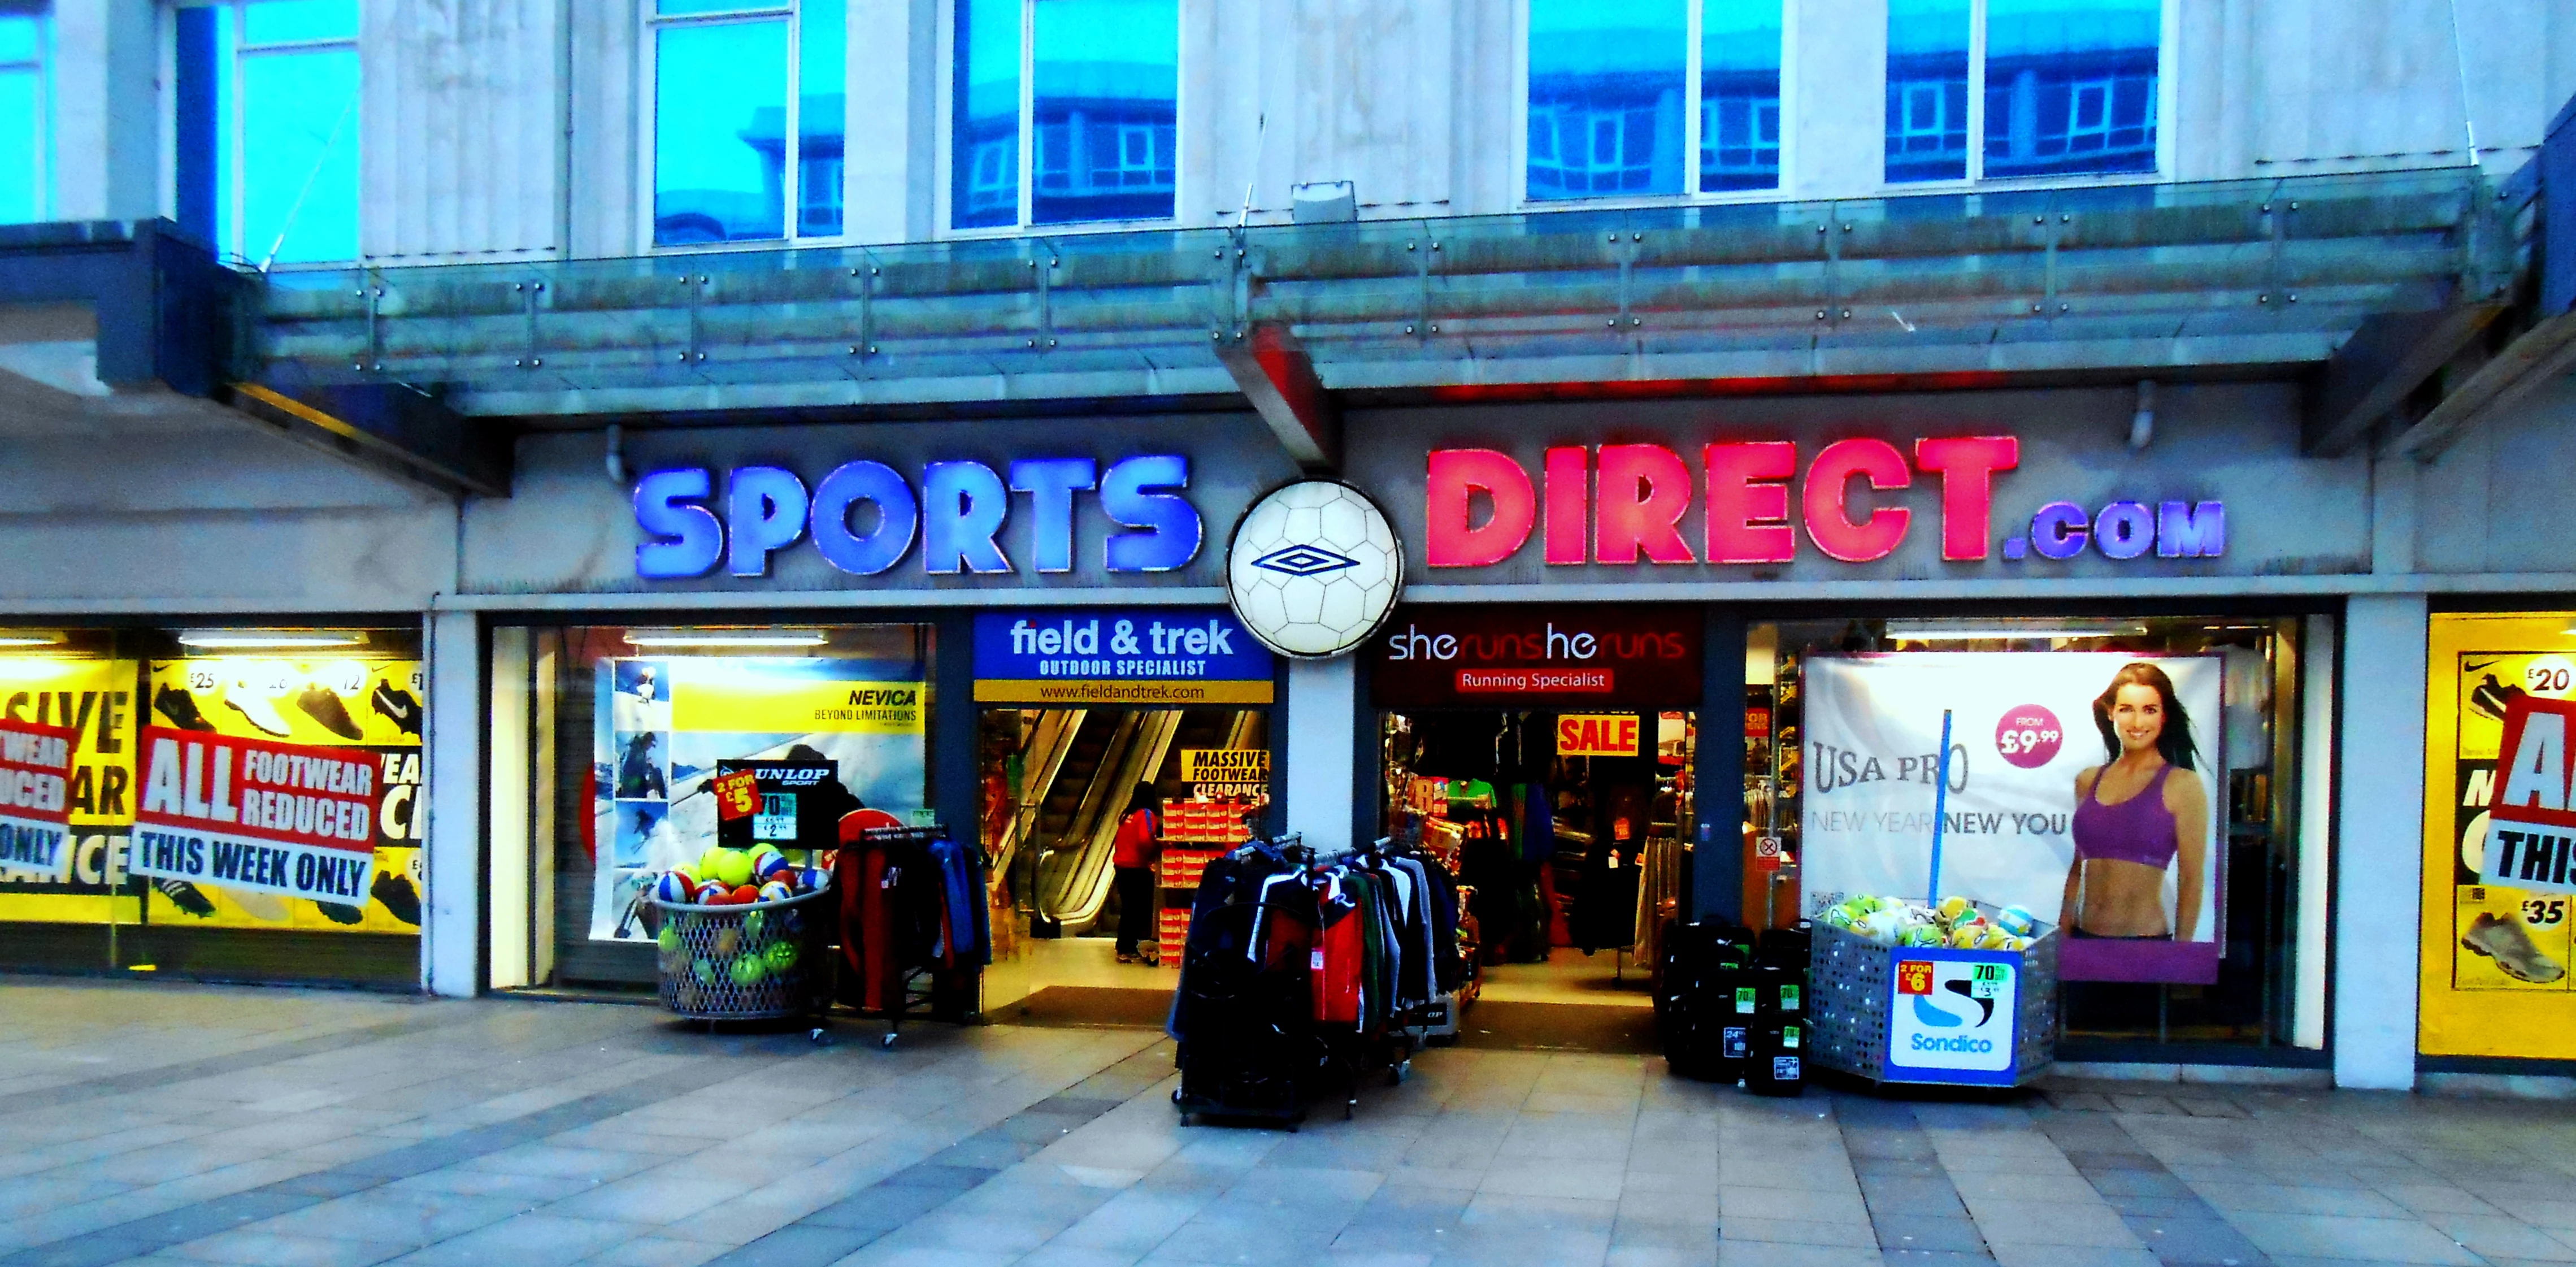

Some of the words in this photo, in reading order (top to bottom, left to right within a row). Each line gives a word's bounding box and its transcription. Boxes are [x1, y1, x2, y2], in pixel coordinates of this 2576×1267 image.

[633, 454, 1204, 578] SPORTS
[1010, 619, 1098, 655] field
[1111, 619, 1141, 655] &
[1149, 620, 1233, 655] trek
[1040, 659, 1111, 675] OUTDOOR
[1117, 659, 1206, 676] SPECIALIST
[190, 672, 214, 689] £25
[1462, 672, 1526, 689] Running
[1531, 672, 1605, 687] Specialist
[2527, 668, 2570, 691] £20
[849, 690, 916, 706] NEVICA
[1041, 684, 1205, 699] www.fieldandtrek.com
[815, 709, 853, 720] BEYOND
[856, 710, 916, 721] LIMITATIONS
[2016, 717, 2044, 726] FROM
[1560, 718, 1637, 752] SALE
[2001, 729, 2059, 754] £9.99
[1193, 751, 1267, 767] MASSIVE
[1813, 741, 1886, 794] USA
[1896, 743, 1970, 795] PRO
[141, 737, 238, 823] ALL
[244, 749, 373, 797] FOOTWEAR
[741, 768, 830, 780] UNLOP
[1193, 767, 1269, 781] FOOTWEAR
[717, 782, 726, 793] 2
[728, 774, 755, 790] FOR
[726, 787, 753, 813] £5
[243, 788, 371, 841] REDUCED
[1812, 810, 1865, 832] NEW
[1875, 812, 1934, 834] YEAR
[1943, 812, 2004, 834] NEW
[2012, 812, 2067, 835] YOU
[141, 831, 205, 877] THIS
[212, 840, 290, 889] WEEK
[296, 852, 367, 899] ONLY
[2521, 900, 2565, 925] £35
[1910, 965, 1932, 973] FOR
[1905, 973, 1926, 991] £6
[1911, 1033, 1992, 1053] Sondico
